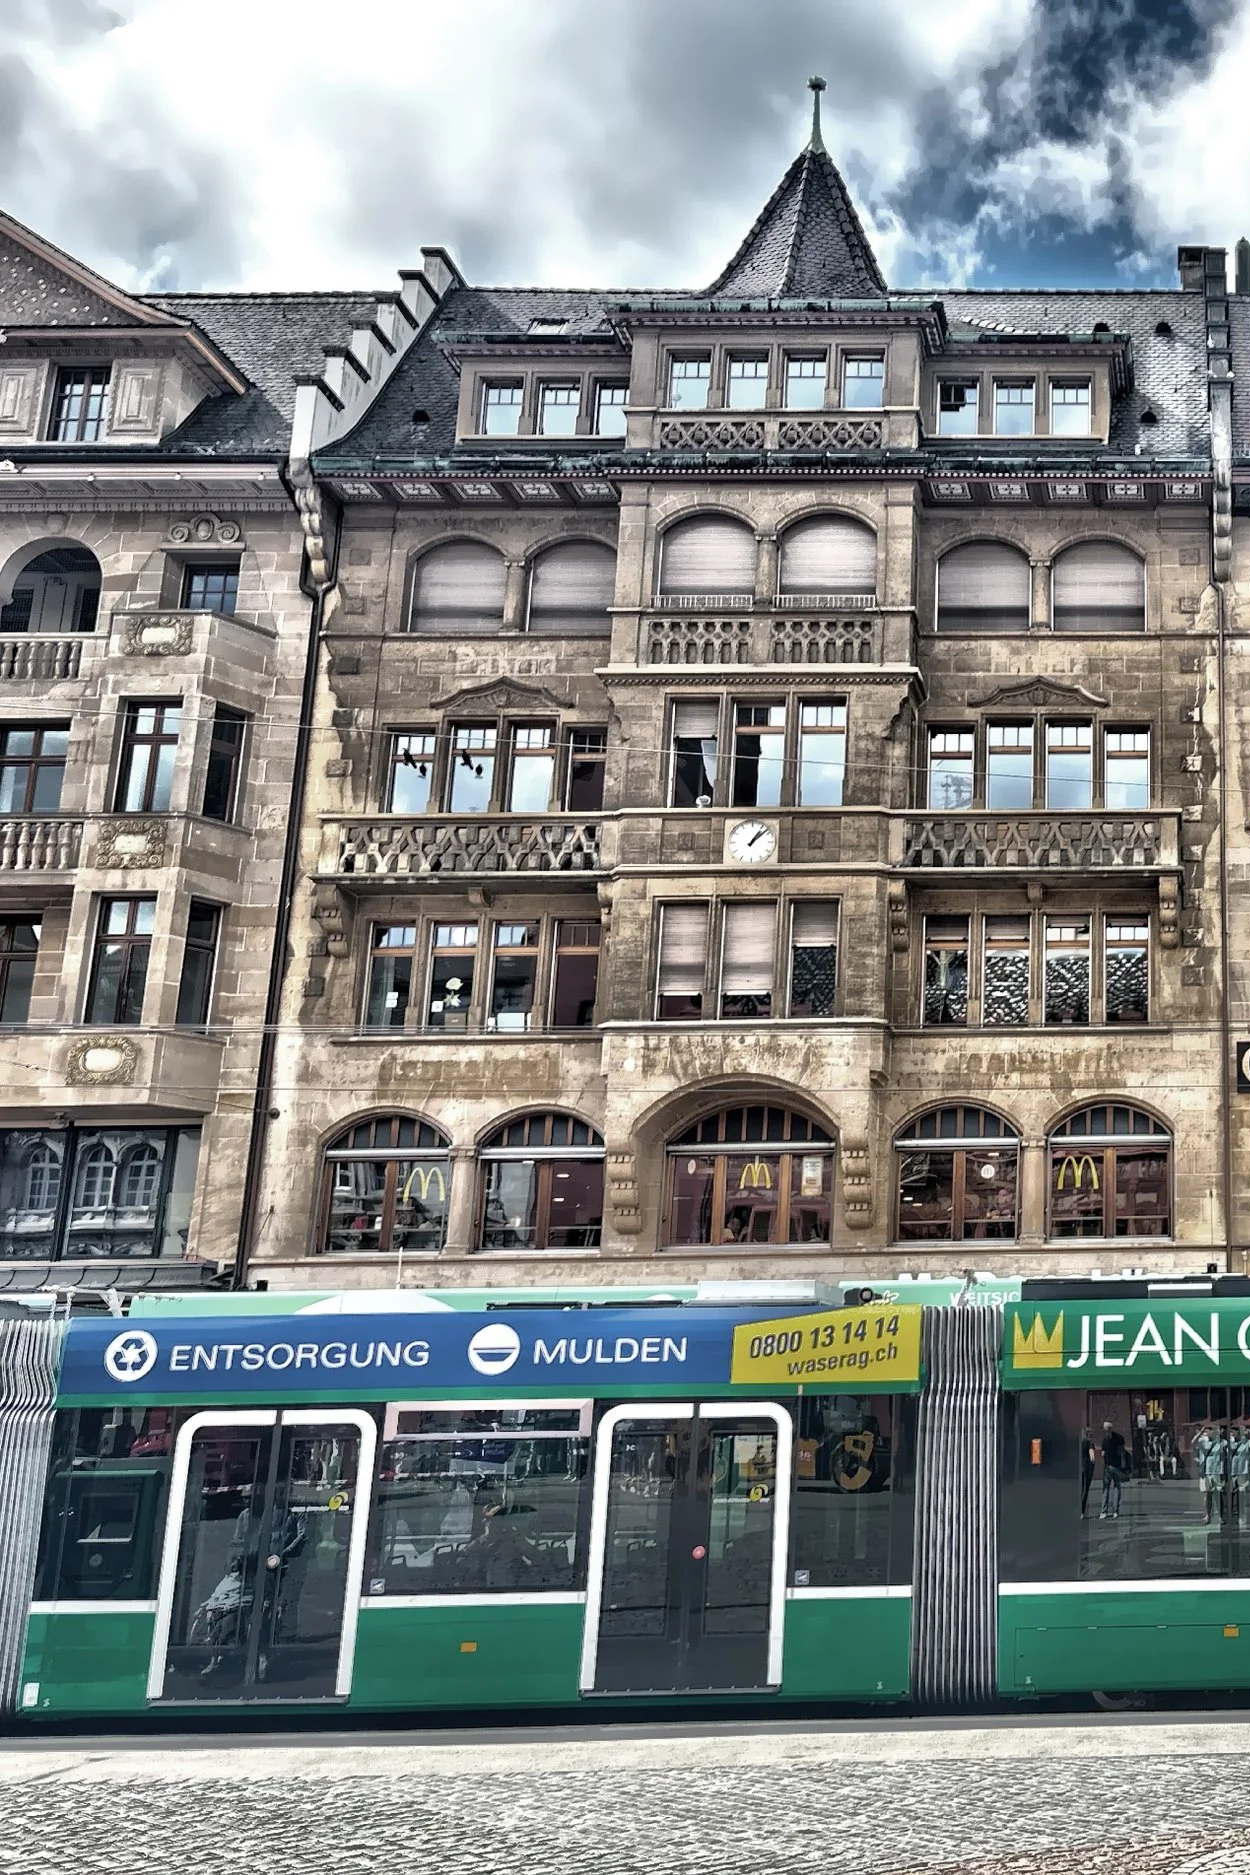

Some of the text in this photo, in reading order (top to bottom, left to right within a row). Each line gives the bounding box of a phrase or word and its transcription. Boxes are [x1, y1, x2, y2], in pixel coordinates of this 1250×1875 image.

[171, 1337, 687, 1371] ENTSORGUNG MULDEN
[750, 1314, 899, 1359] 0800 13 14 14
[1066, 1312, 1220, 1368] JEAN
[787, 1342, 898, 1376] waserag.ch
